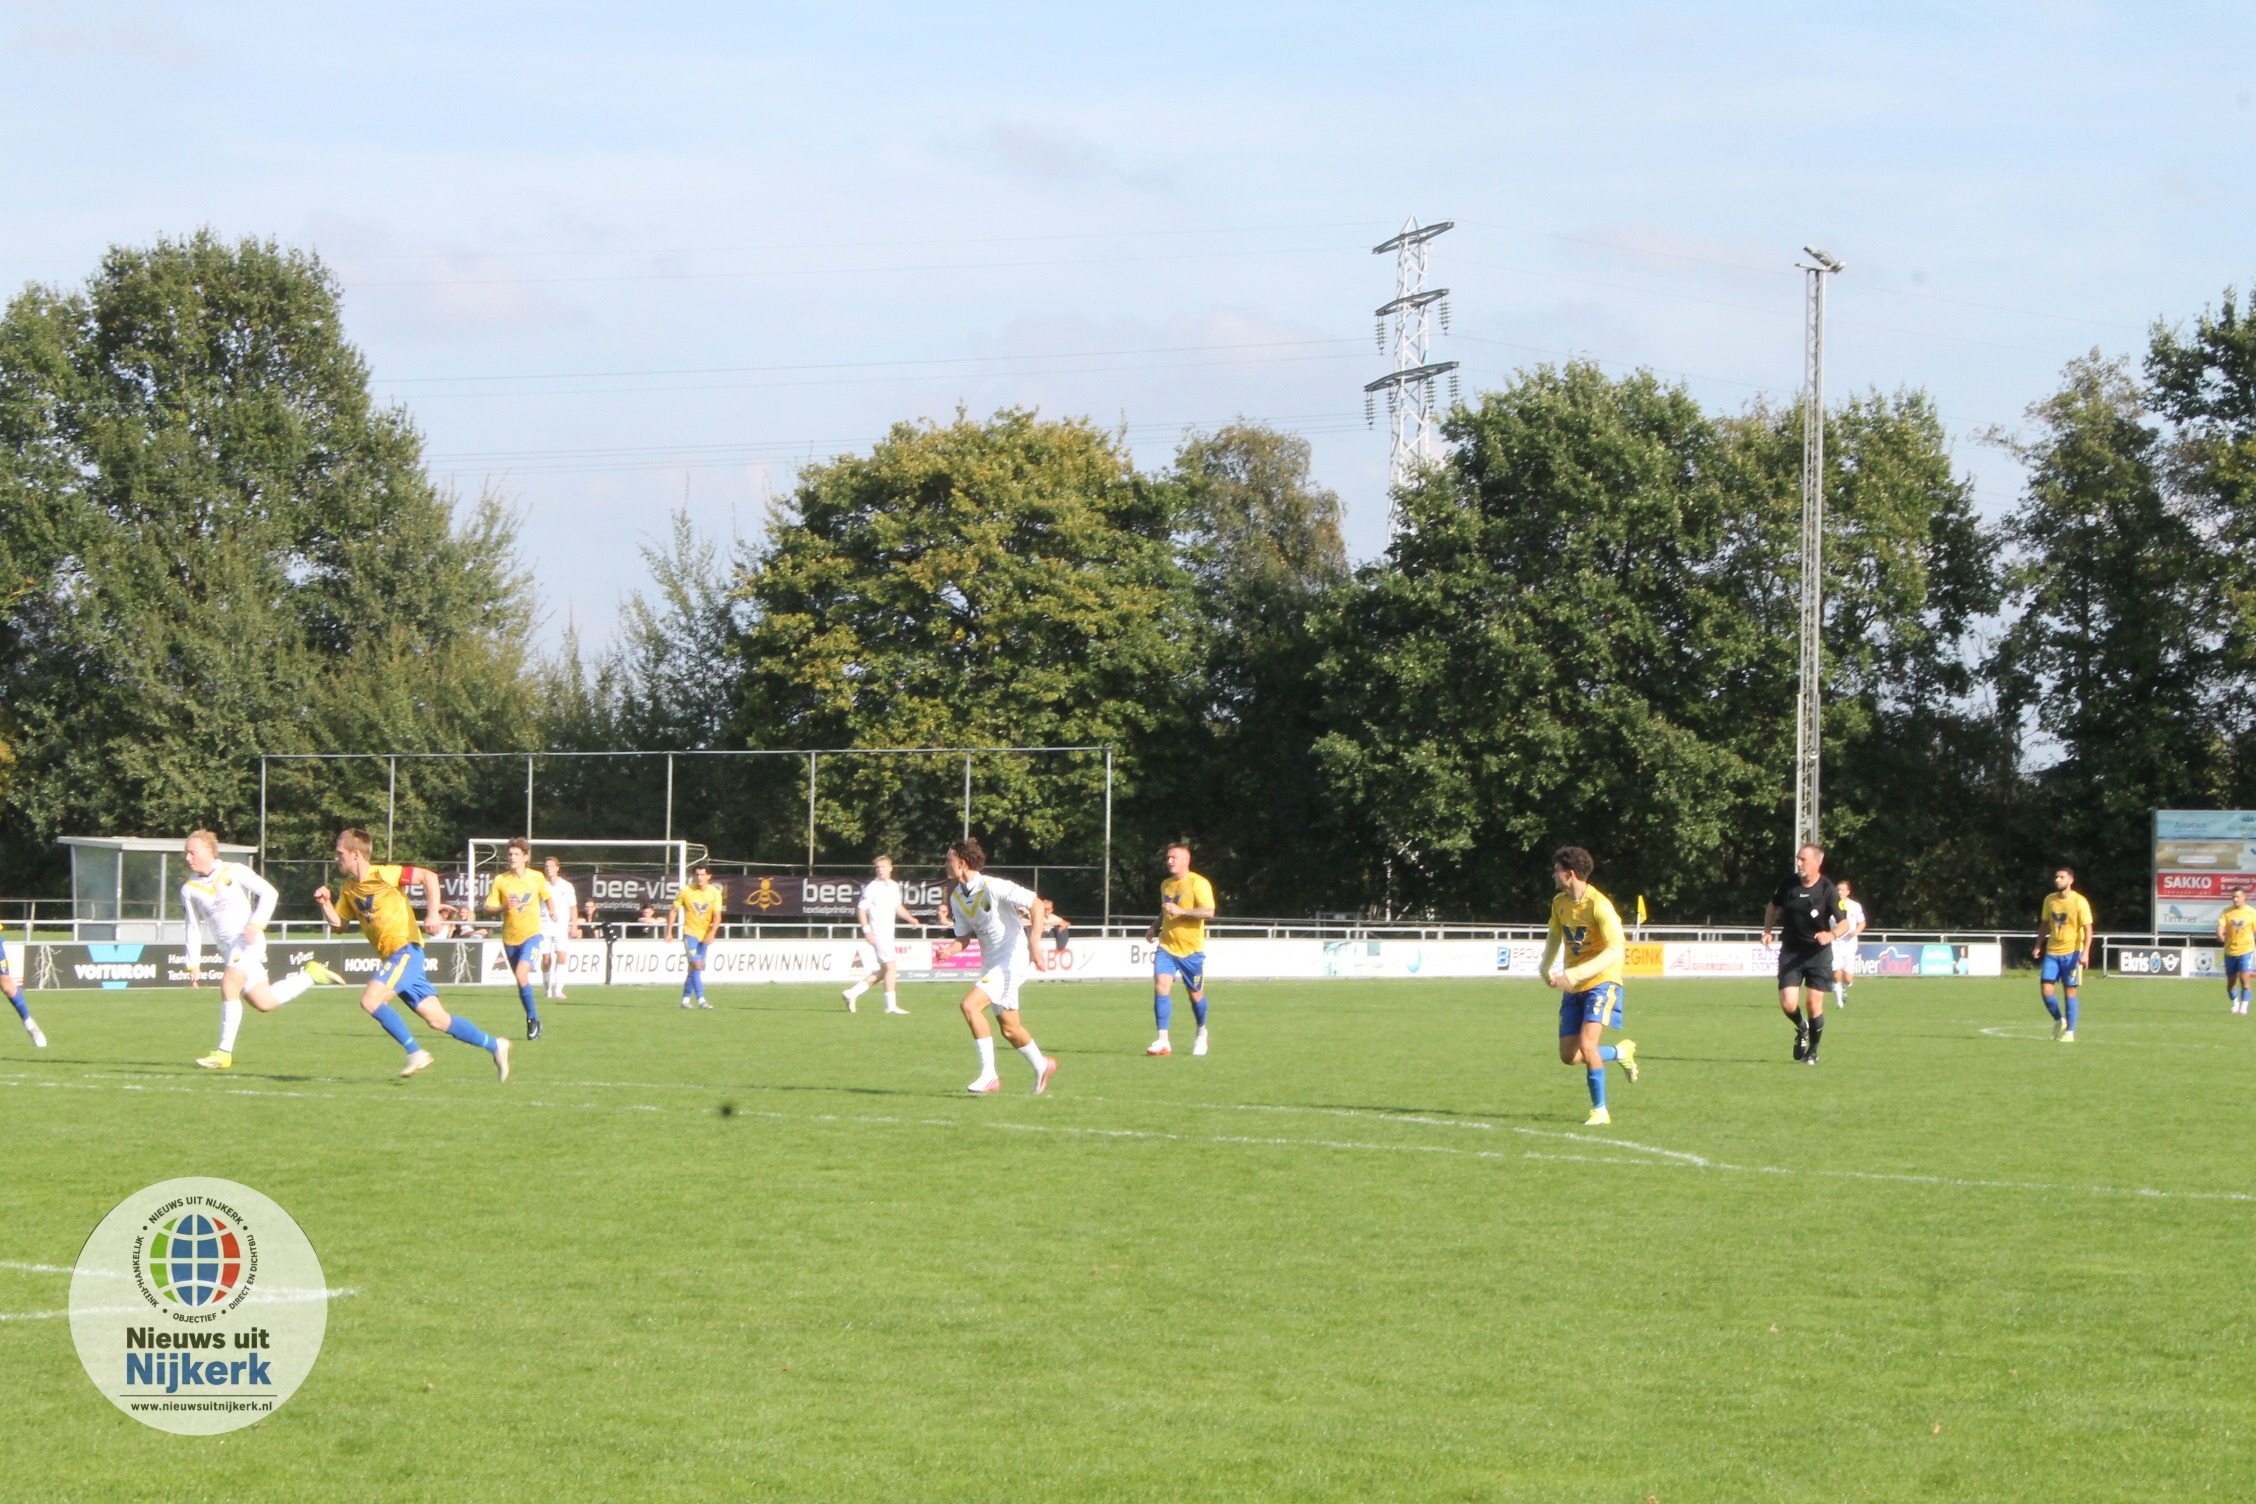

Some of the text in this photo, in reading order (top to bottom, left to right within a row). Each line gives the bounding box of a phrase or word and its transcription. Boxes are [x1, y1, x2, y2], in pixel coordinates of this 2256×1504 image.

[2164, 877, 2212, 889] SAKKO
[713, 953, 833, 972] OVERWINNING
[1624, 948, 1663, 965] EGINK
[2121, 952, 2149, 972] Ekris
[74, 964, 157, 980] VOITURON
